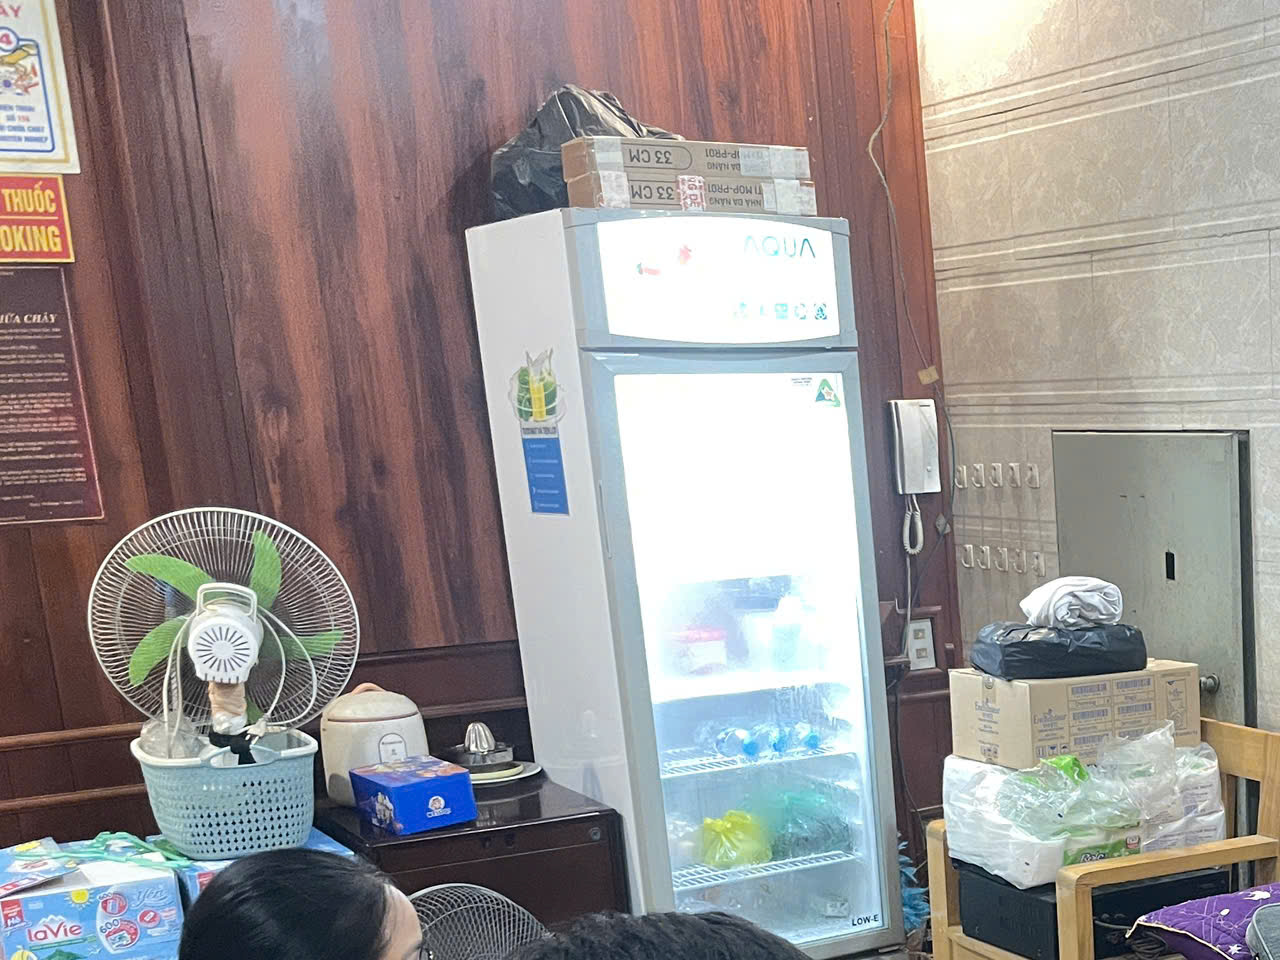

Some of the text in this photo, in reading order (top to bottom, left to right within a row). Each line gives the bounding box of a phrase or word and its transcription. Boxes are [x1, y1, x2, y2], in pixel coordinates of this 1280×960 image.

[629, 149, 673, 165] 33 CM
[2, 181, 56, 213] THUỐC
[631, 185, 675, 200] 33 CM
[0, 226, 62, 252] OKING
[744, 235, 816, 258] AQUA
[99, 918, 119, 934] 600
[851, 914, 880, 927] LOW-E
[27, 922, 83, 942] laVie
